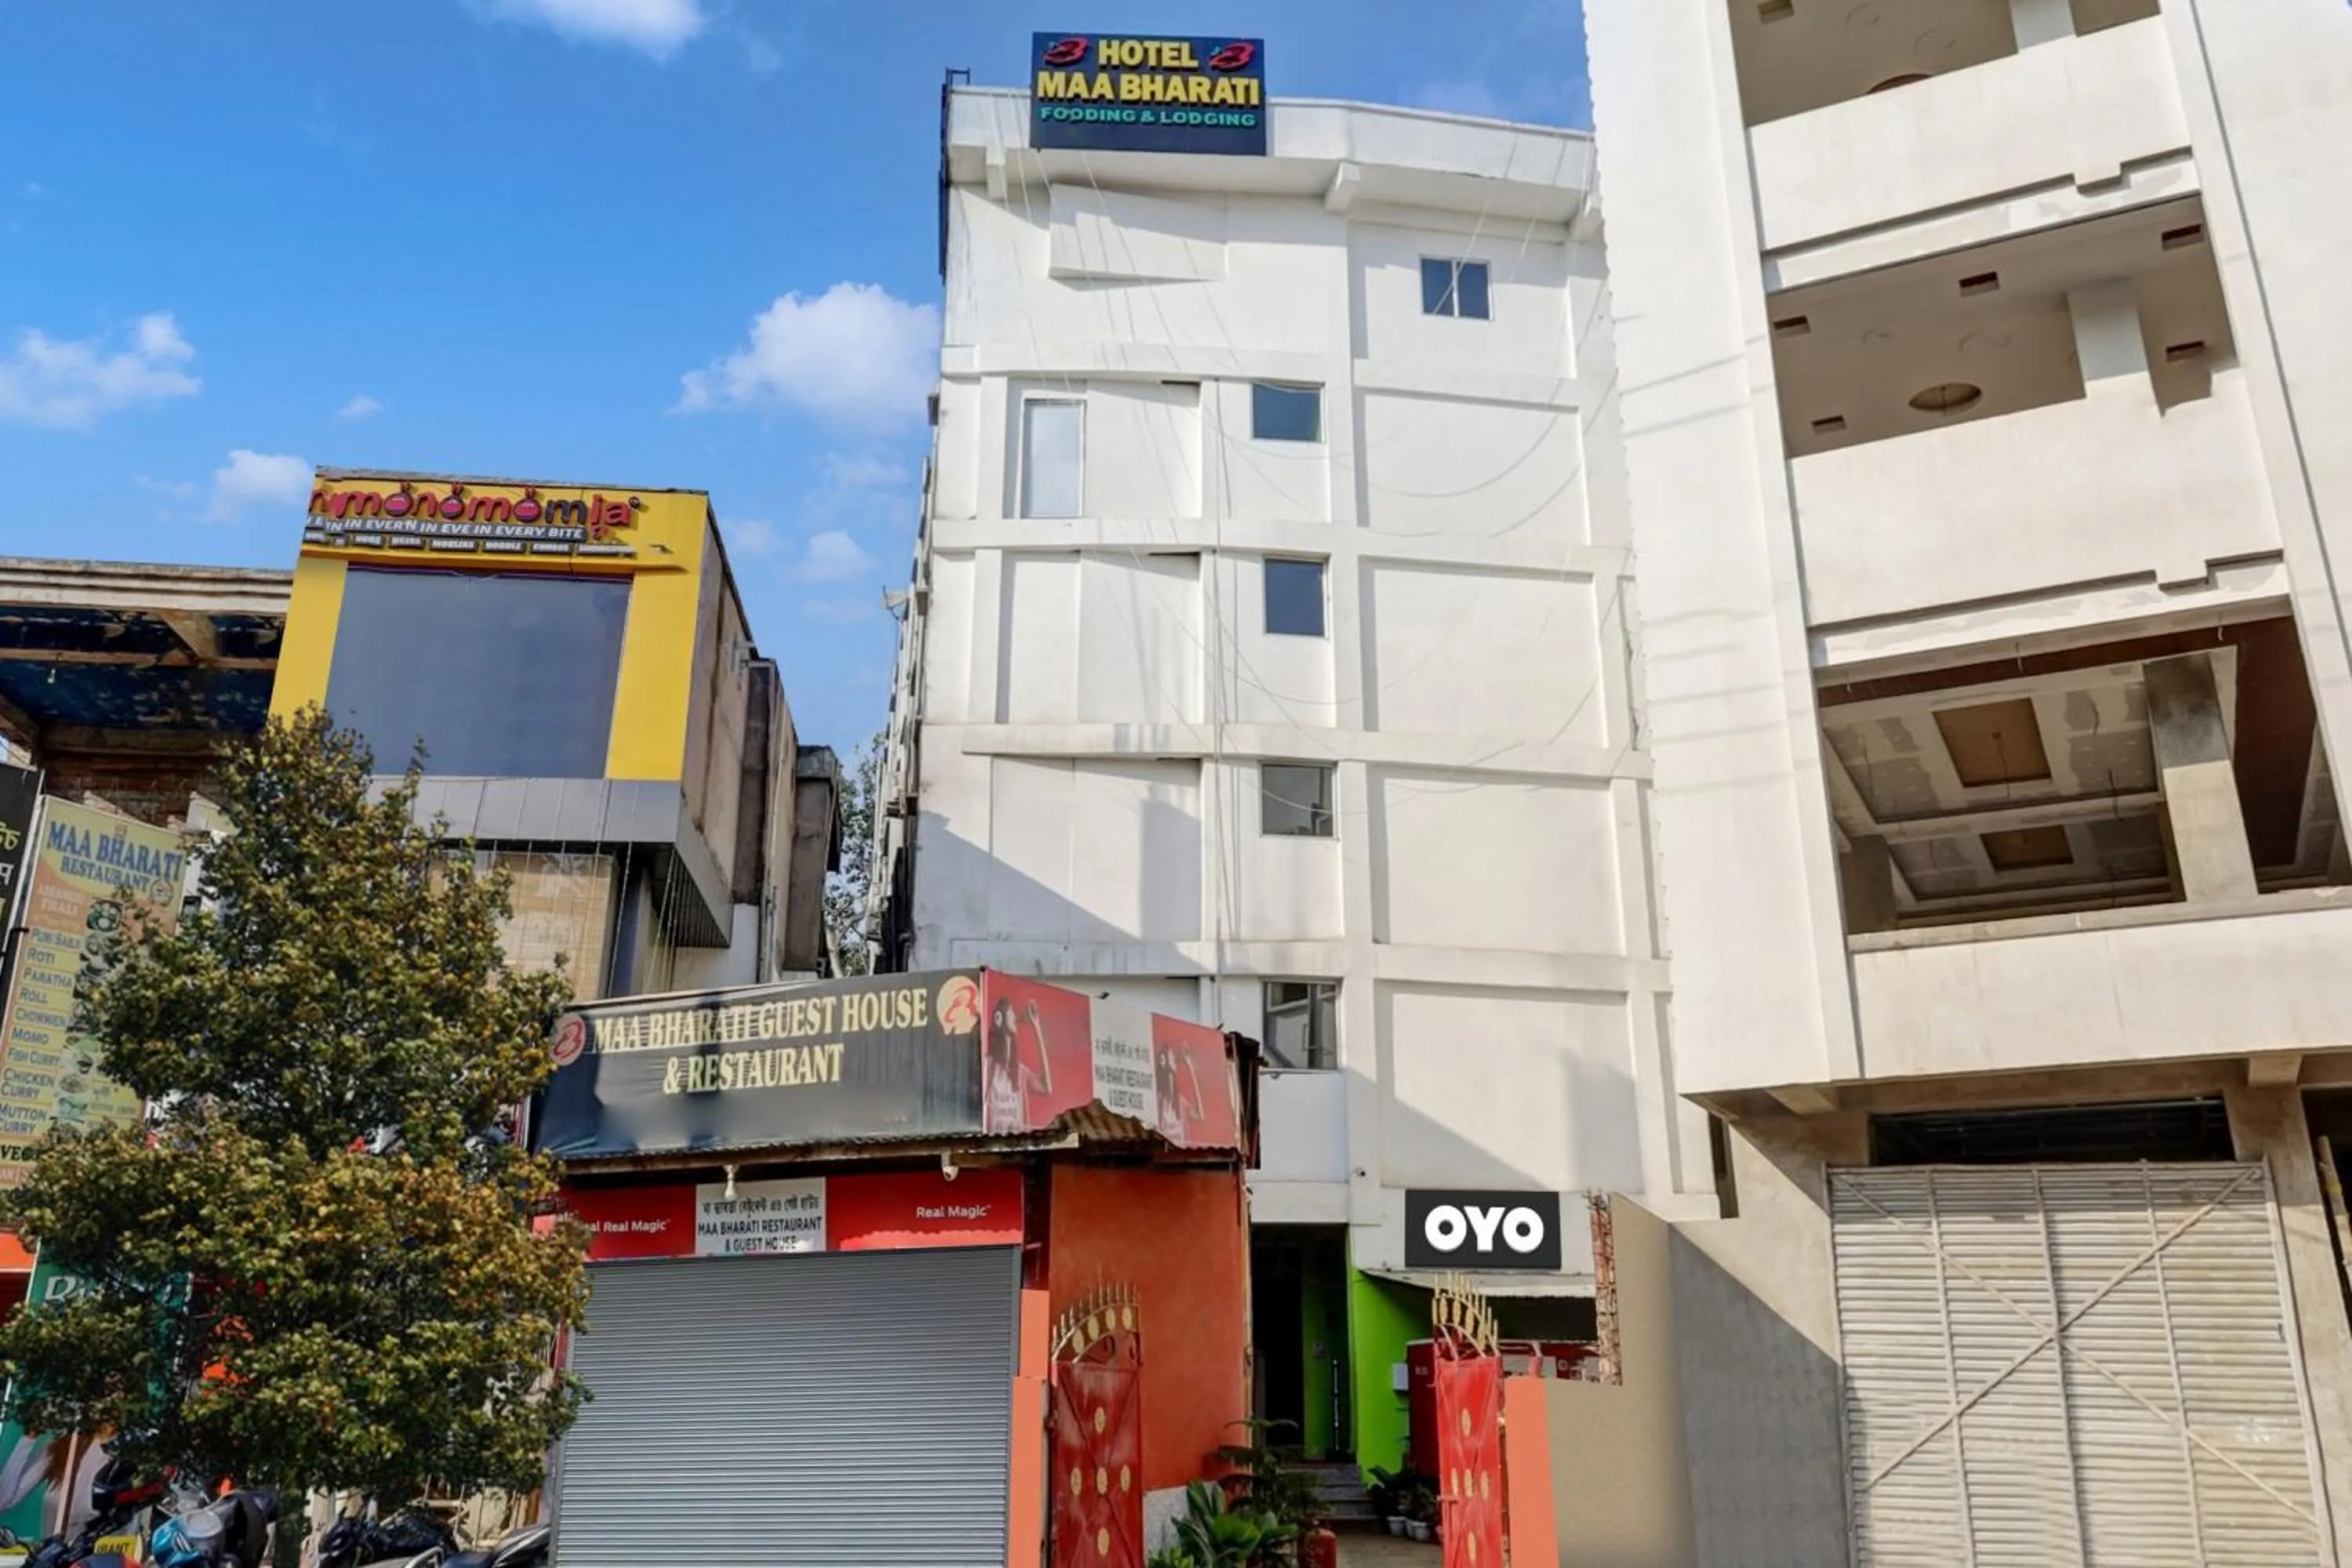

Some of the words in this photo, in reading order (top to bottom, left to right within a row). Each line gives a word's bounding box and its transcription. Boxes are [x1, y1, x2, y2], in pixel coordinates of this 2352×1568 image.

[1098, 39, 1199, 67] HOTEL
[1036, 71, 1115, 101] MAA
[1119, 73, 1260, 106] BHARATI
[1040, 107, 1136, 123] FOODING
[1140, 109, 1155, 122] &
[1160, 110, 1256, 126] LODGING
[474, 524, 492, 535] IN
[495, 525, 546, 537] EVERY
[549, 528, 582, 539] BITE
[47, 821, 92, 858] MAA
[96, 834, 183, 881] BHARATI
[61, 855, 151, 891] RESTAURANT
[27, 948, 55, 964] ROTI
[592, 1014, 642, 1054] MAA
[647, 1004, 753, 1048] BHARATI
[758, 996, 838, 1040] GUEST
[842, 988, 928, 1032] HOUSE
[4, 1068, 55, 1087] CHICKEN
[662, 1058, 681, 1094] &
[686, 1044, 845, 1093] RESTAURANT
[916, 1206, 945, 1218] Real
[948, 1204, 988, 1219] Magic
[604, 1221, 628, 1232] Real
[631, 1220, 666, 1233] Magic
[698, 1222, 718, 1236] MAA
[720, 1219, 760, 1235] BHARATI
[762, 1216, 822, 1233] RESTAURANT
[1425, 1204, 1544, 1254] OYO
[733, 1237, 762, 1252] GUEST
